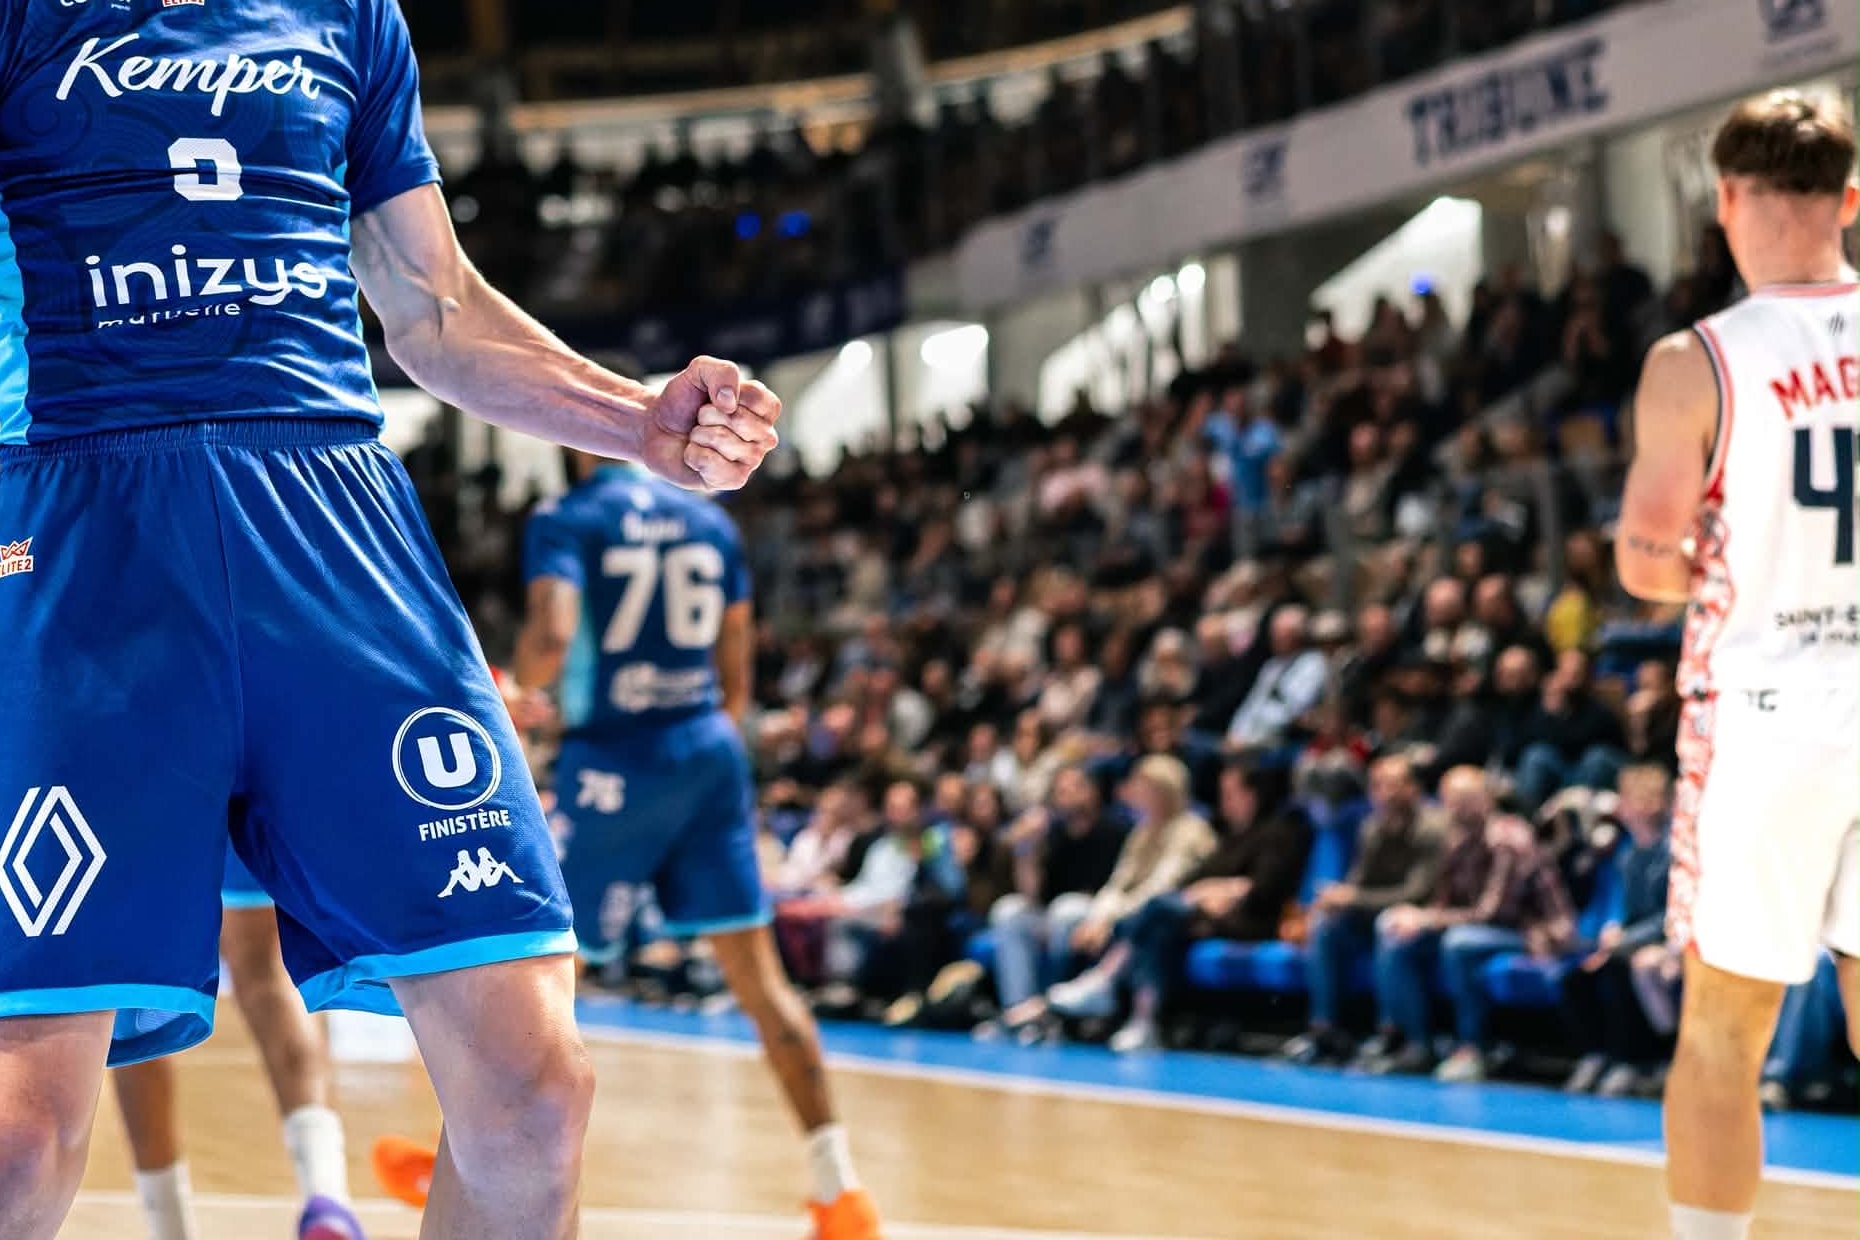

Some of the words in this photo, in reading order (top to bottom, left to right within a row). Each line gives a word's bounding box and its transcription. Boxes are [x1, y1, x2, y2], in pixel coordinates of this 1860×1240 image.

[55, 33, 320, 117] Kemper
[85, 244, 328, 307] inizys
[601, 543, 725, 654] 76
[417, 732, 477, 789] U
[576, 769, 626, 813] 76
[418, 808, 511, 842] FINISTÈRE
